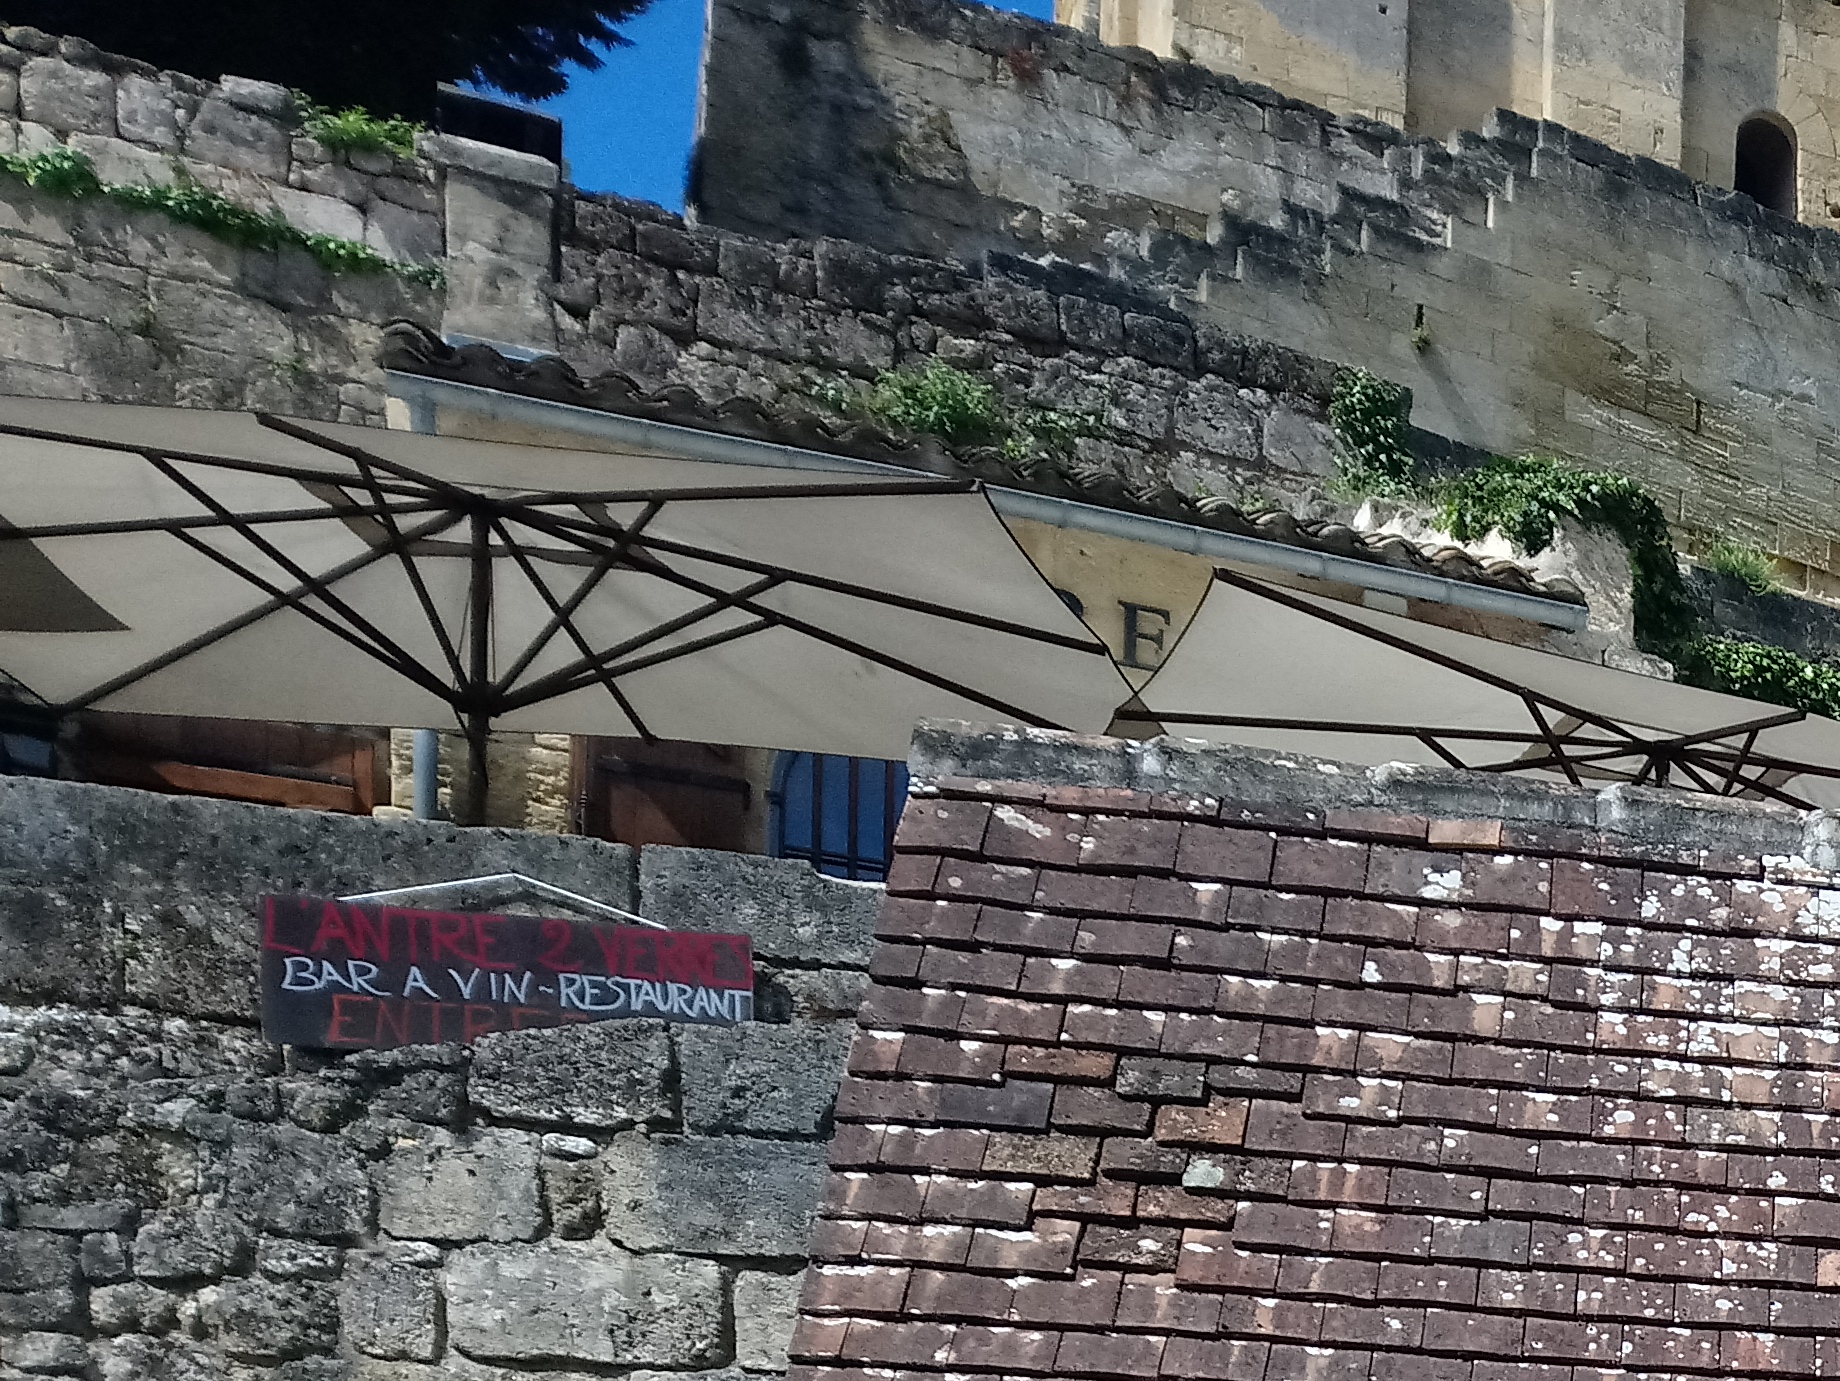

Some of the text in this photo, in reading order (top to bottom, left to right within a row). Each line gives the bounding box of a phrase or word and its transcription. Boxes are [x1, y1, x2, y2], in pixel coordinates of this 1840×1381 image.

[264, 896, 517, 970] L'ANTRE
[537, 918, 584, 972] 2
[280, 956, 393, 998] BAR
[402, 965, 441, 999] A
[447, 966, 533, 1004] VIN
[557, 971, 754, 1023] RESTAURANT
[327, 994, 589, 1044] ENTR
